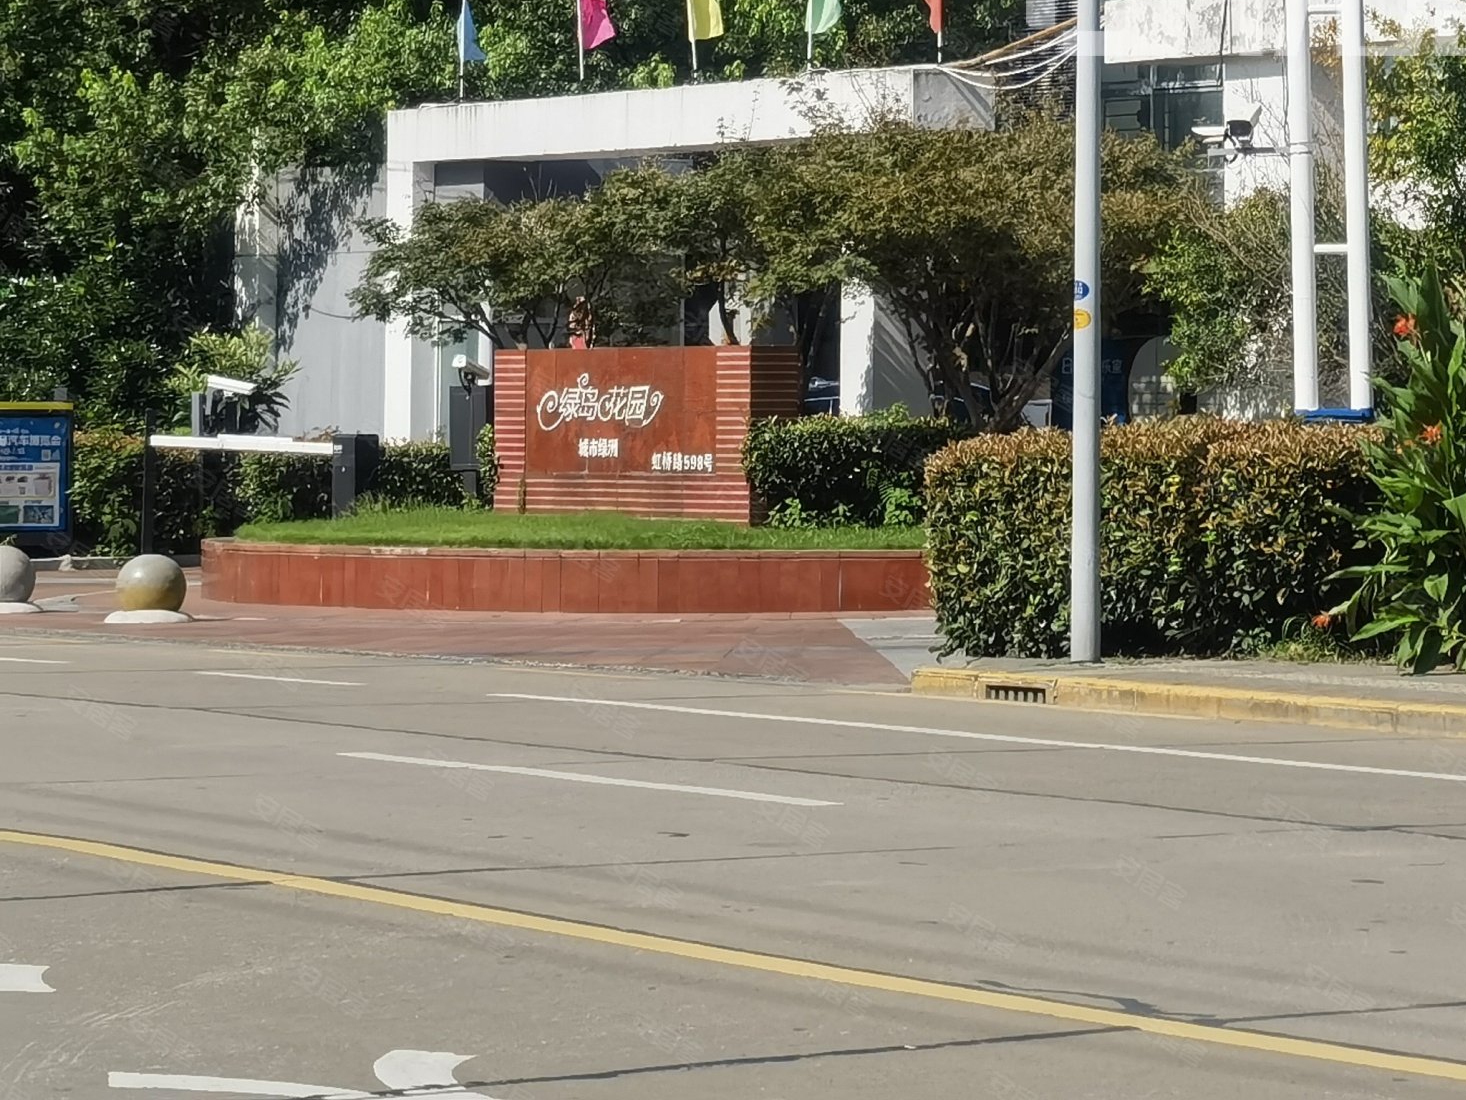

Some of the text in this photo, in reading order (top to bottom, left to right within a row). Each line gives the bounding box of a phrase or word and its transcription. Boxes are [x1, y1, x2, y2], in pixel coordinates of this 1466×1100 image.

[537, 373, 664, 431] 绿岛花园
[652, 451, 715, 472] 虹桥路598号
